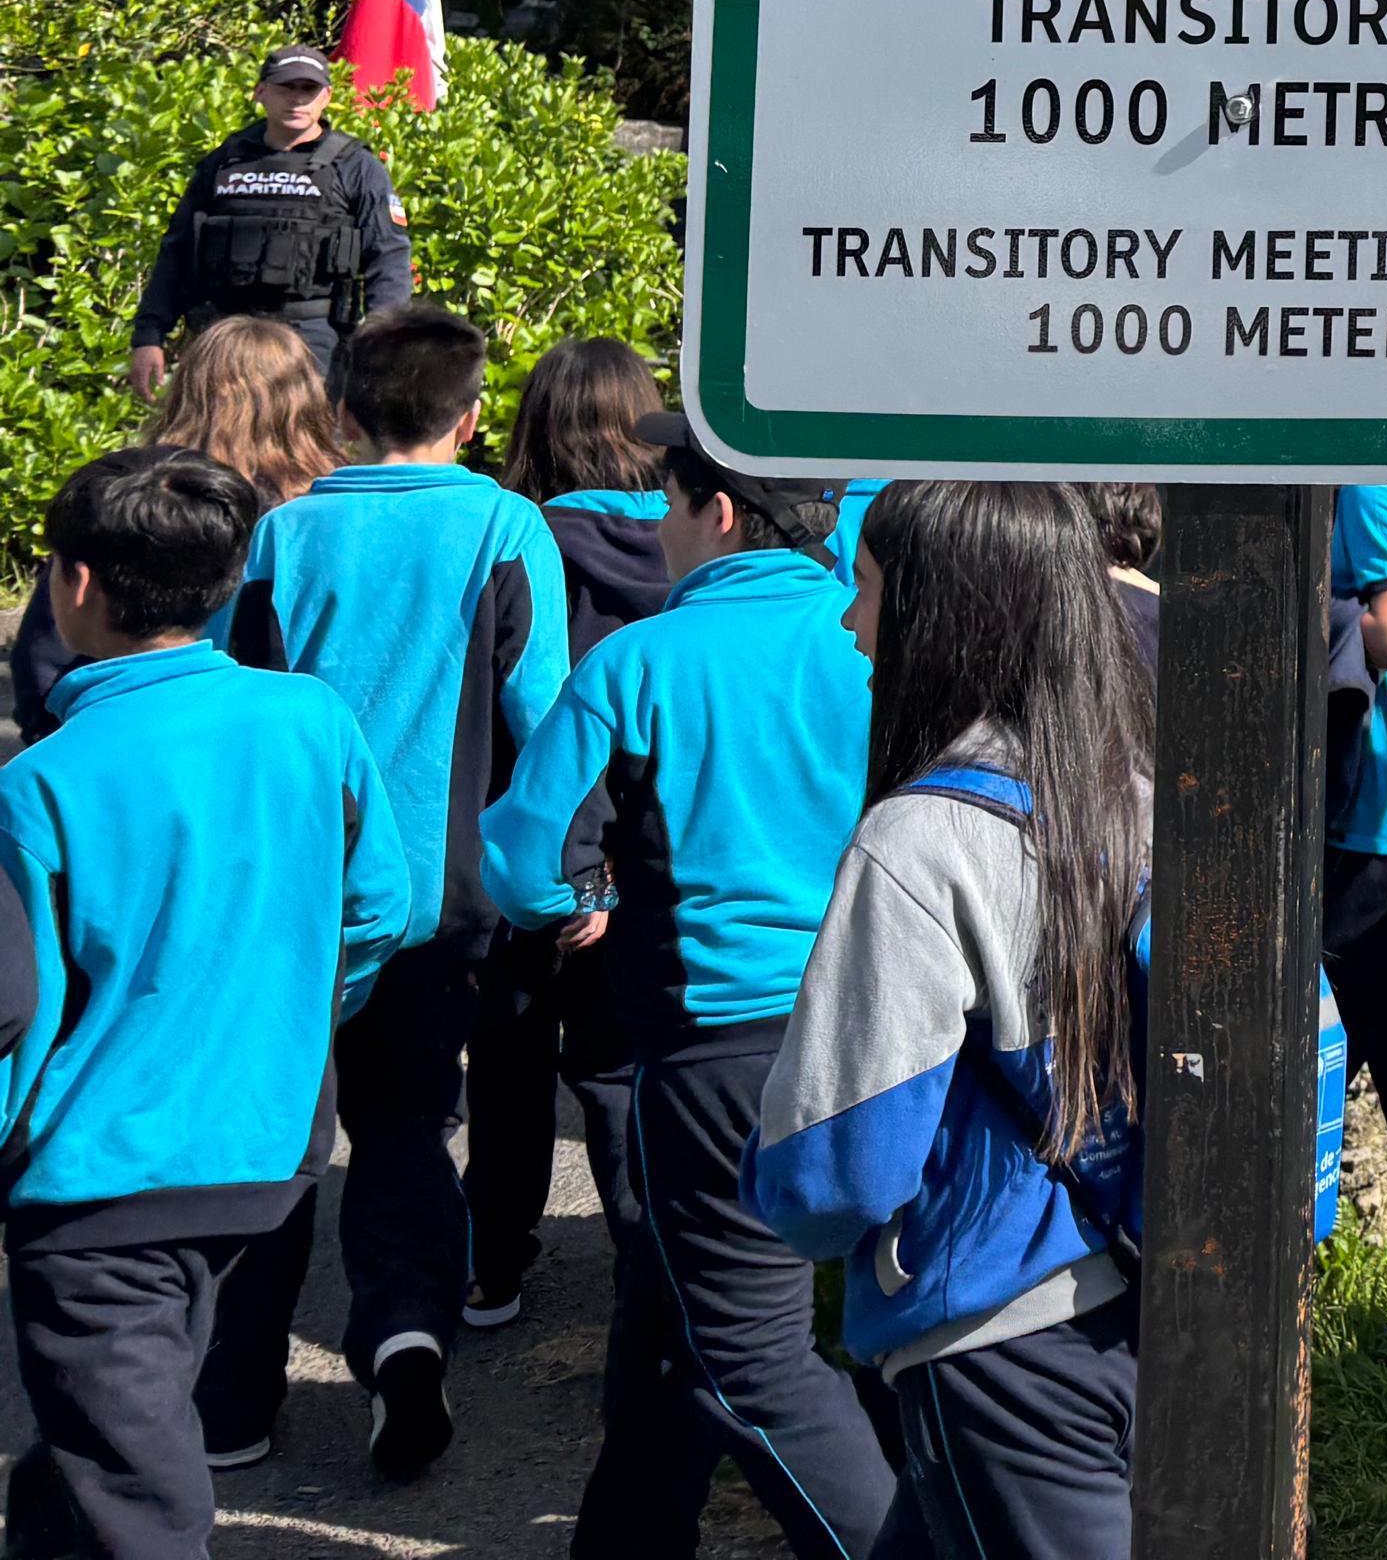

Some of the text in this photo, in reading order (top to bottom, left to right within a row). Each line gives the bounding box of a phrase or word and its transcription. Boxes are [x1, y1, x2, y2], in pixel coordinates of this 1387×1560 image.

[969, 77, 1168, 146] 1000
[217, 183, 321, 197] MARITIMA
[229, 172, 312, 185] POLICIA
[802, 226, 1184, 280] TRANSITORY
[1027, 302, 1192, 357] 1000
